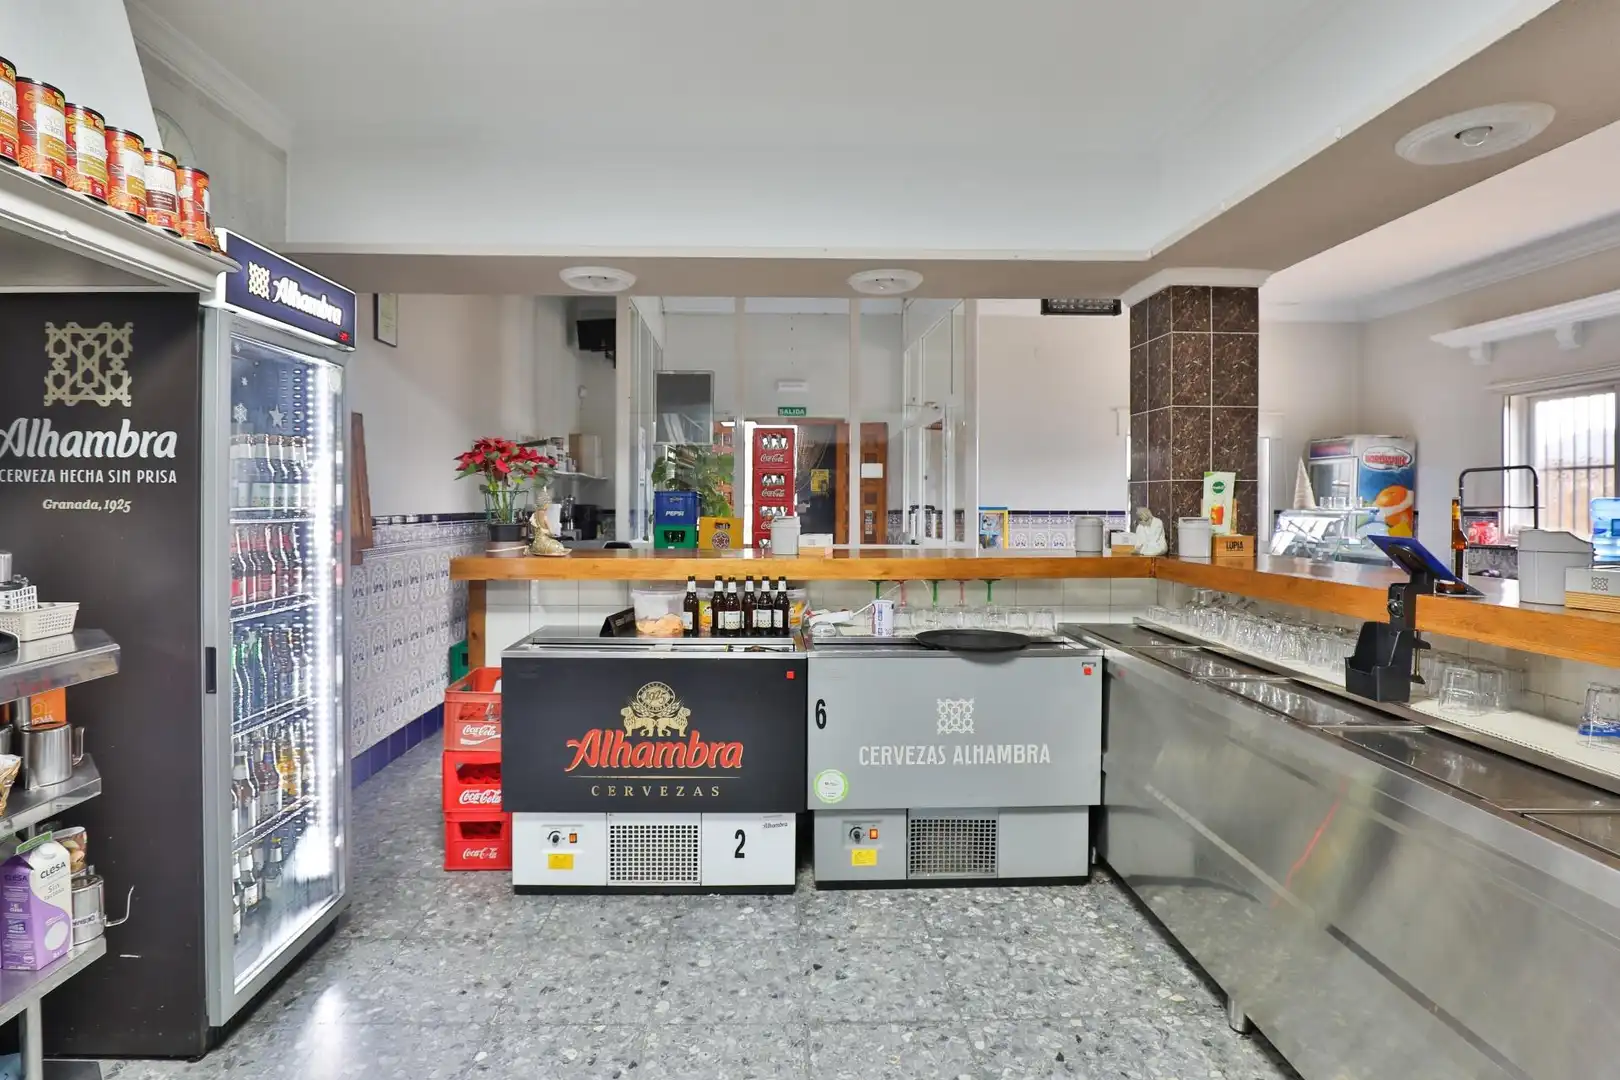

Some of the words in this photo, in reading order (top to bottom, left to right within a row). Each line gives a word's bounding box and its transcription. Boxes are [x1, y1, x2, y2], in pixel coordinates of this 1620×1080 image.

[272, 277, 342, 326] Alhambra
[0, 417, 178, 458] Alhambra
[0, 469, 56, 484] CERVEZA
[60, 469, 104, 484] HECHA
[108, 469, 131, 484] SIN
[136, 469, 178, 484] PRISA
[42, 499, 102, 511] Granada,
[103, 499, 132, 514] 1925
[815, 699, 827, 730] 6
[564, 728, 744, 772] Alhambra
[858, 744, 946, 766] CERVEZAS
[953, 743, 1051, 765] ALHAMBRA
[591, 785, 720, 798] CERVEZAS
[734, 829, 746, 859] 2
